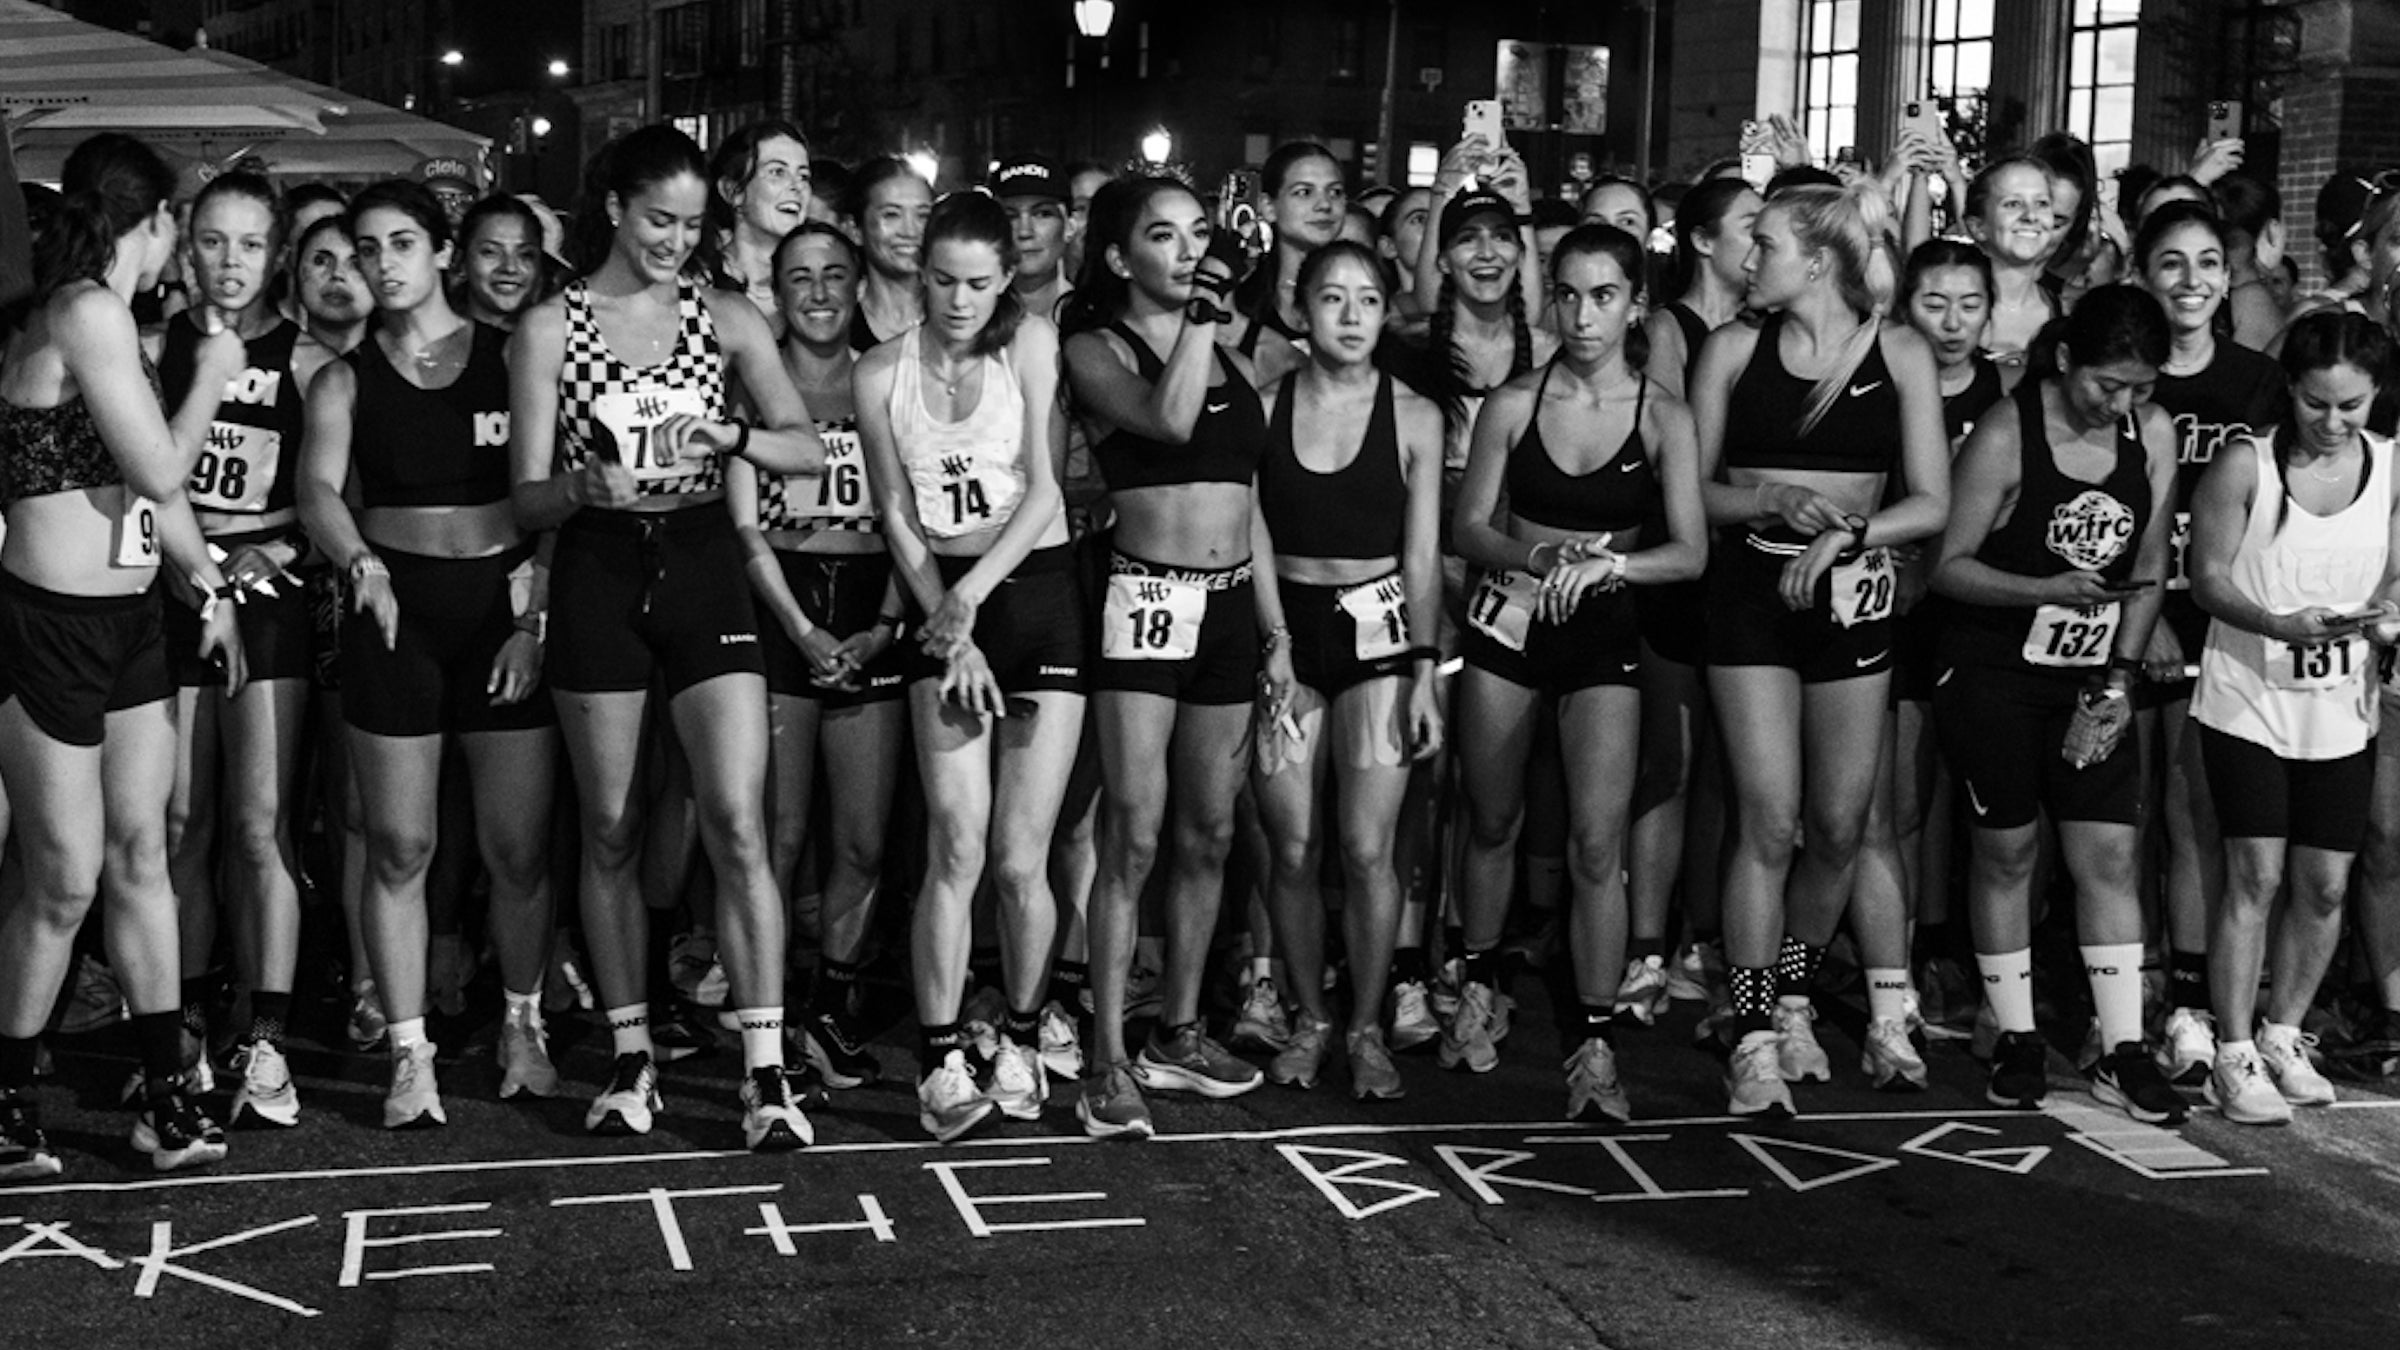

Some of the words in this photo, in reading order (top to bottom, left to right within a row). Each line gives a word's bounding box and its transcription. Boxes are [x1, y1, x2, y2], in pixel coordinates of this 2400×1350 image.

[189, 452, 249, 500] 98
[942, 479, 990, 524] 74
[140, 508, 158, 555] 9
[2053, 515, 2131, 544] wfrc
[1853, 575, 1890, 619] 20
[1128, 608, 1173, 650] 18
[2045, 620, 2110, 658] 132
[2286, 639, 2350, 680] 131
[0, 1202, 503, 1317] AKE
[550, 1156, 1147, 1271] THE
